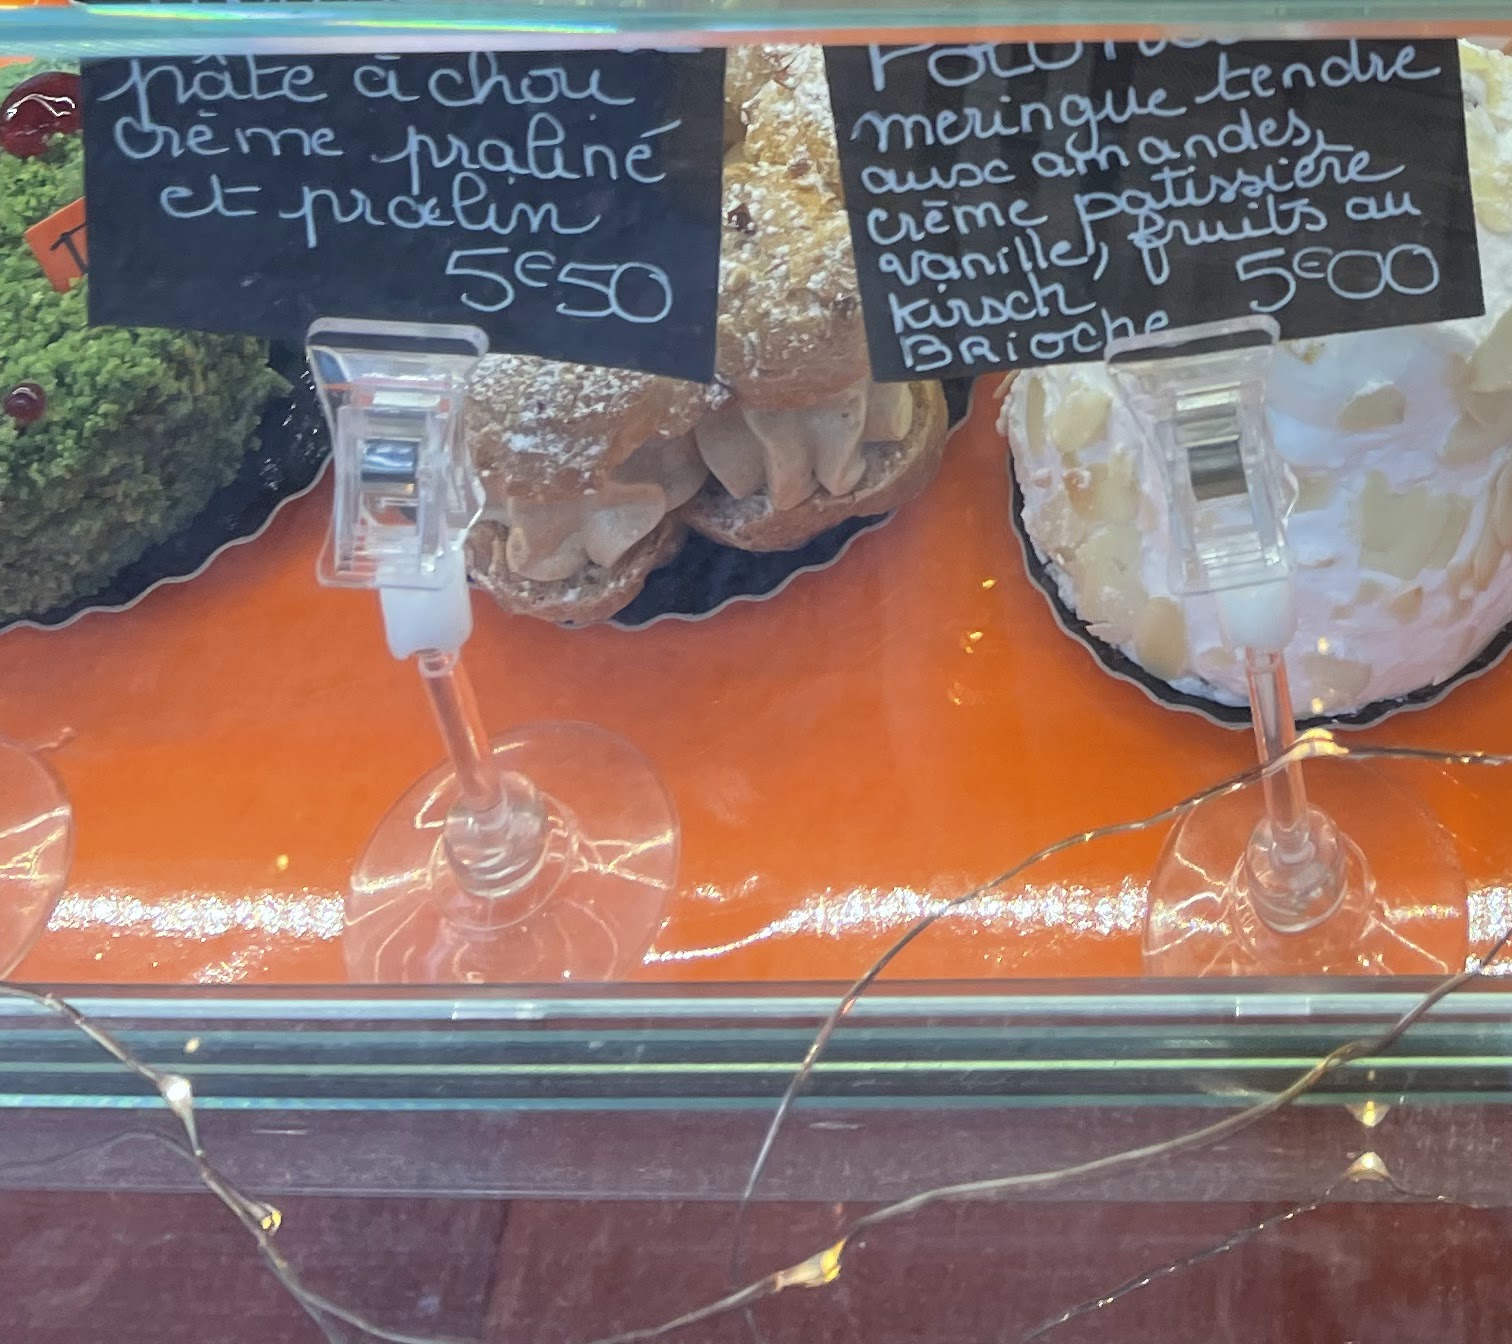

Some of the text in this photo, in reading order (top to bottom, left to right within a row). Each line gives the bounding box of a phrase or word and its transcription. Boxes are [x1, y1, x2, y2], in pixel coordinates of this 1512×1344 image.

[97, 53, 329, 128] pâte
[428, 51, 637, 107] chou
[850, 41, 1441, 157] meringue tendre
[371, 113, 683, 195] praliné
[861, 159, 1016, 195] aux
[159, 173, 263, 219] et
[1126, 194, 1328, 286] fruits
[1346, 191, 1422, 221] au
[887, 271, 1097, 335] kirsch
